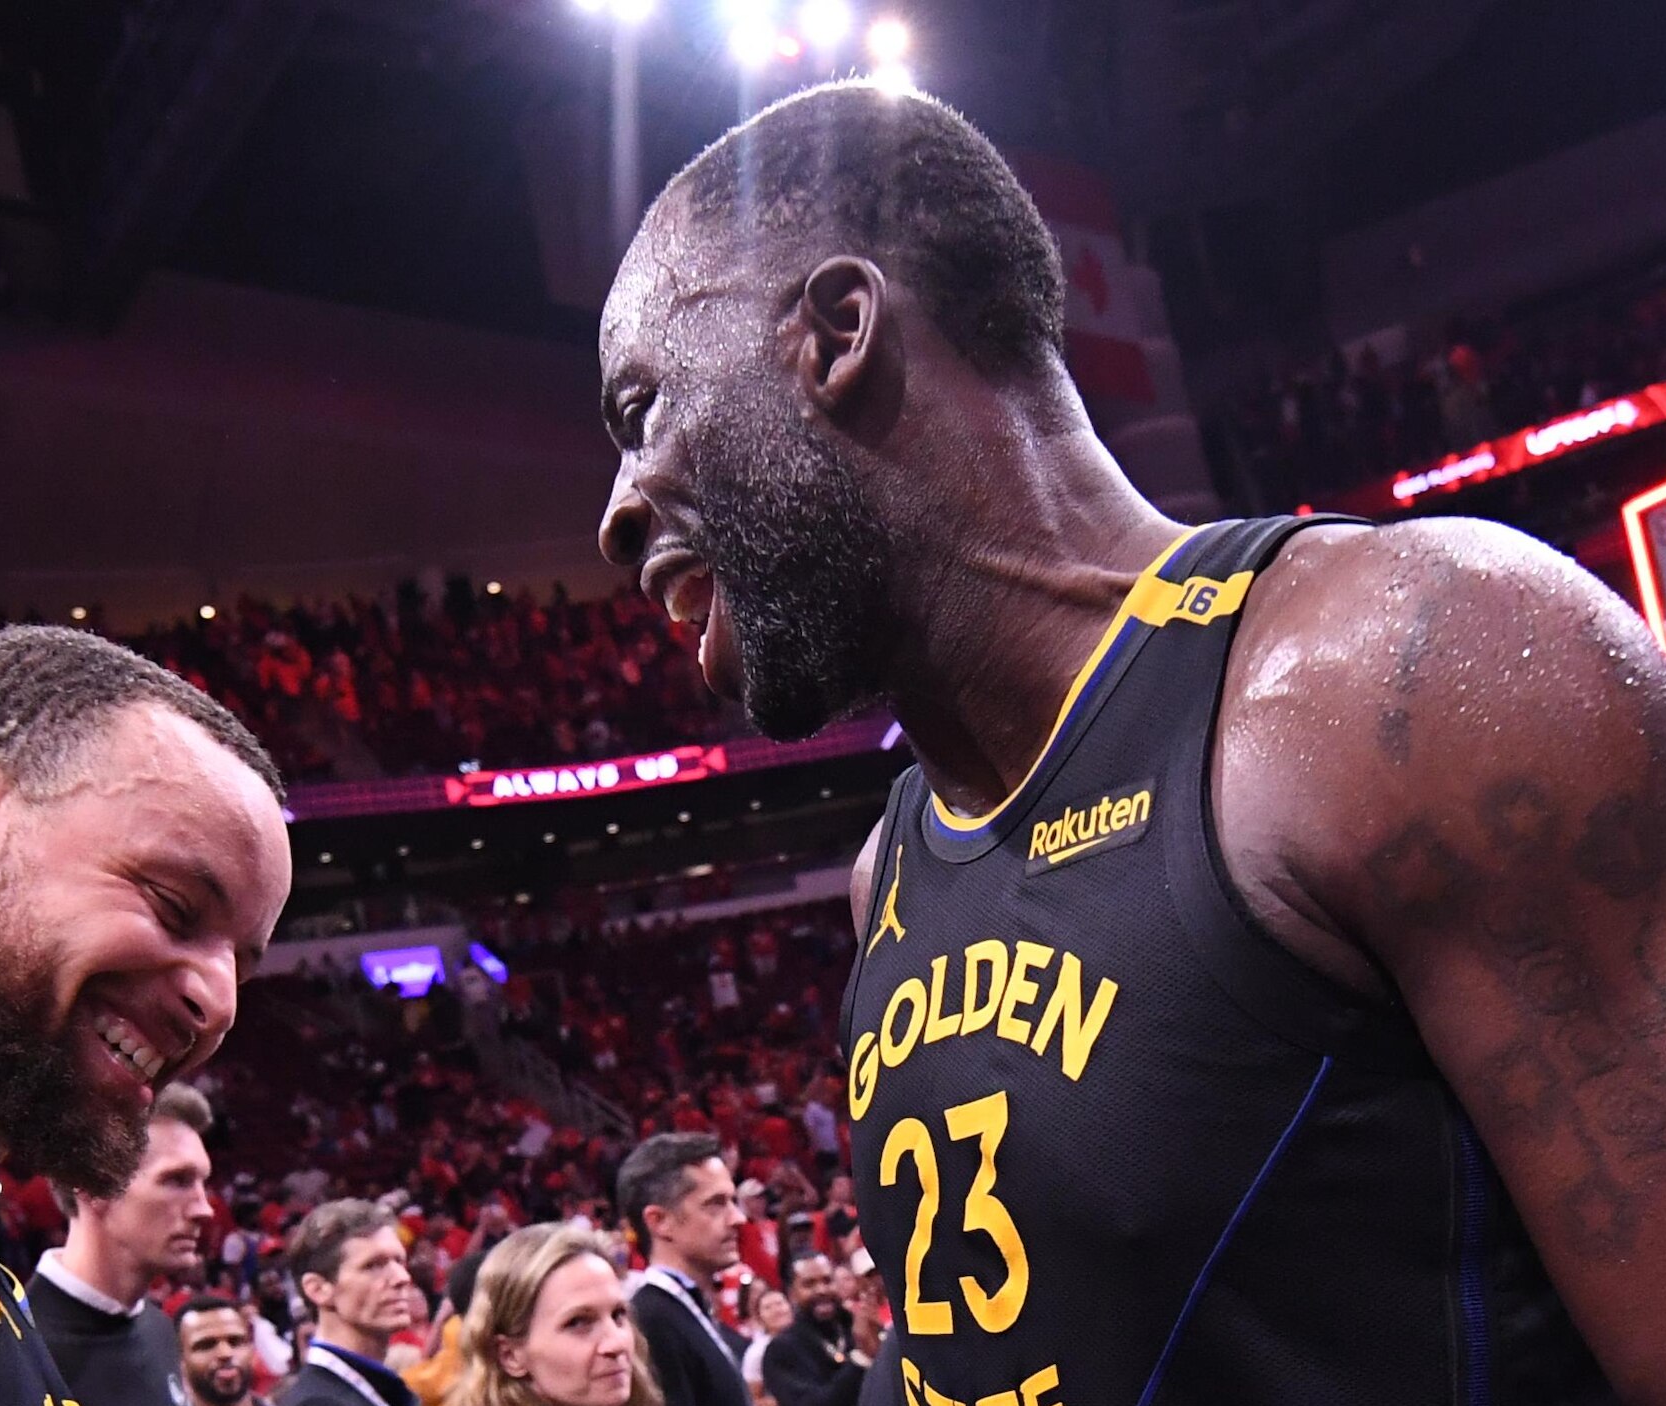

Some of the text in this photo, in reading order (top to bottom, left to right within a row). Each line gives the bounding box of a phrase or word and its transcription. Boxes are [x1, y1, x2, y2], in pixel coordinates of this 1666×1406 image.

[1175, 582, 1219, 616] 16
[492, 762, 621, 799] ALWAYS
[1028, 789, 1151, 862] Rakuten
[849, 940, 1119, 1121] GOLDEN
[879, 1090, 1030, 1335] 23
